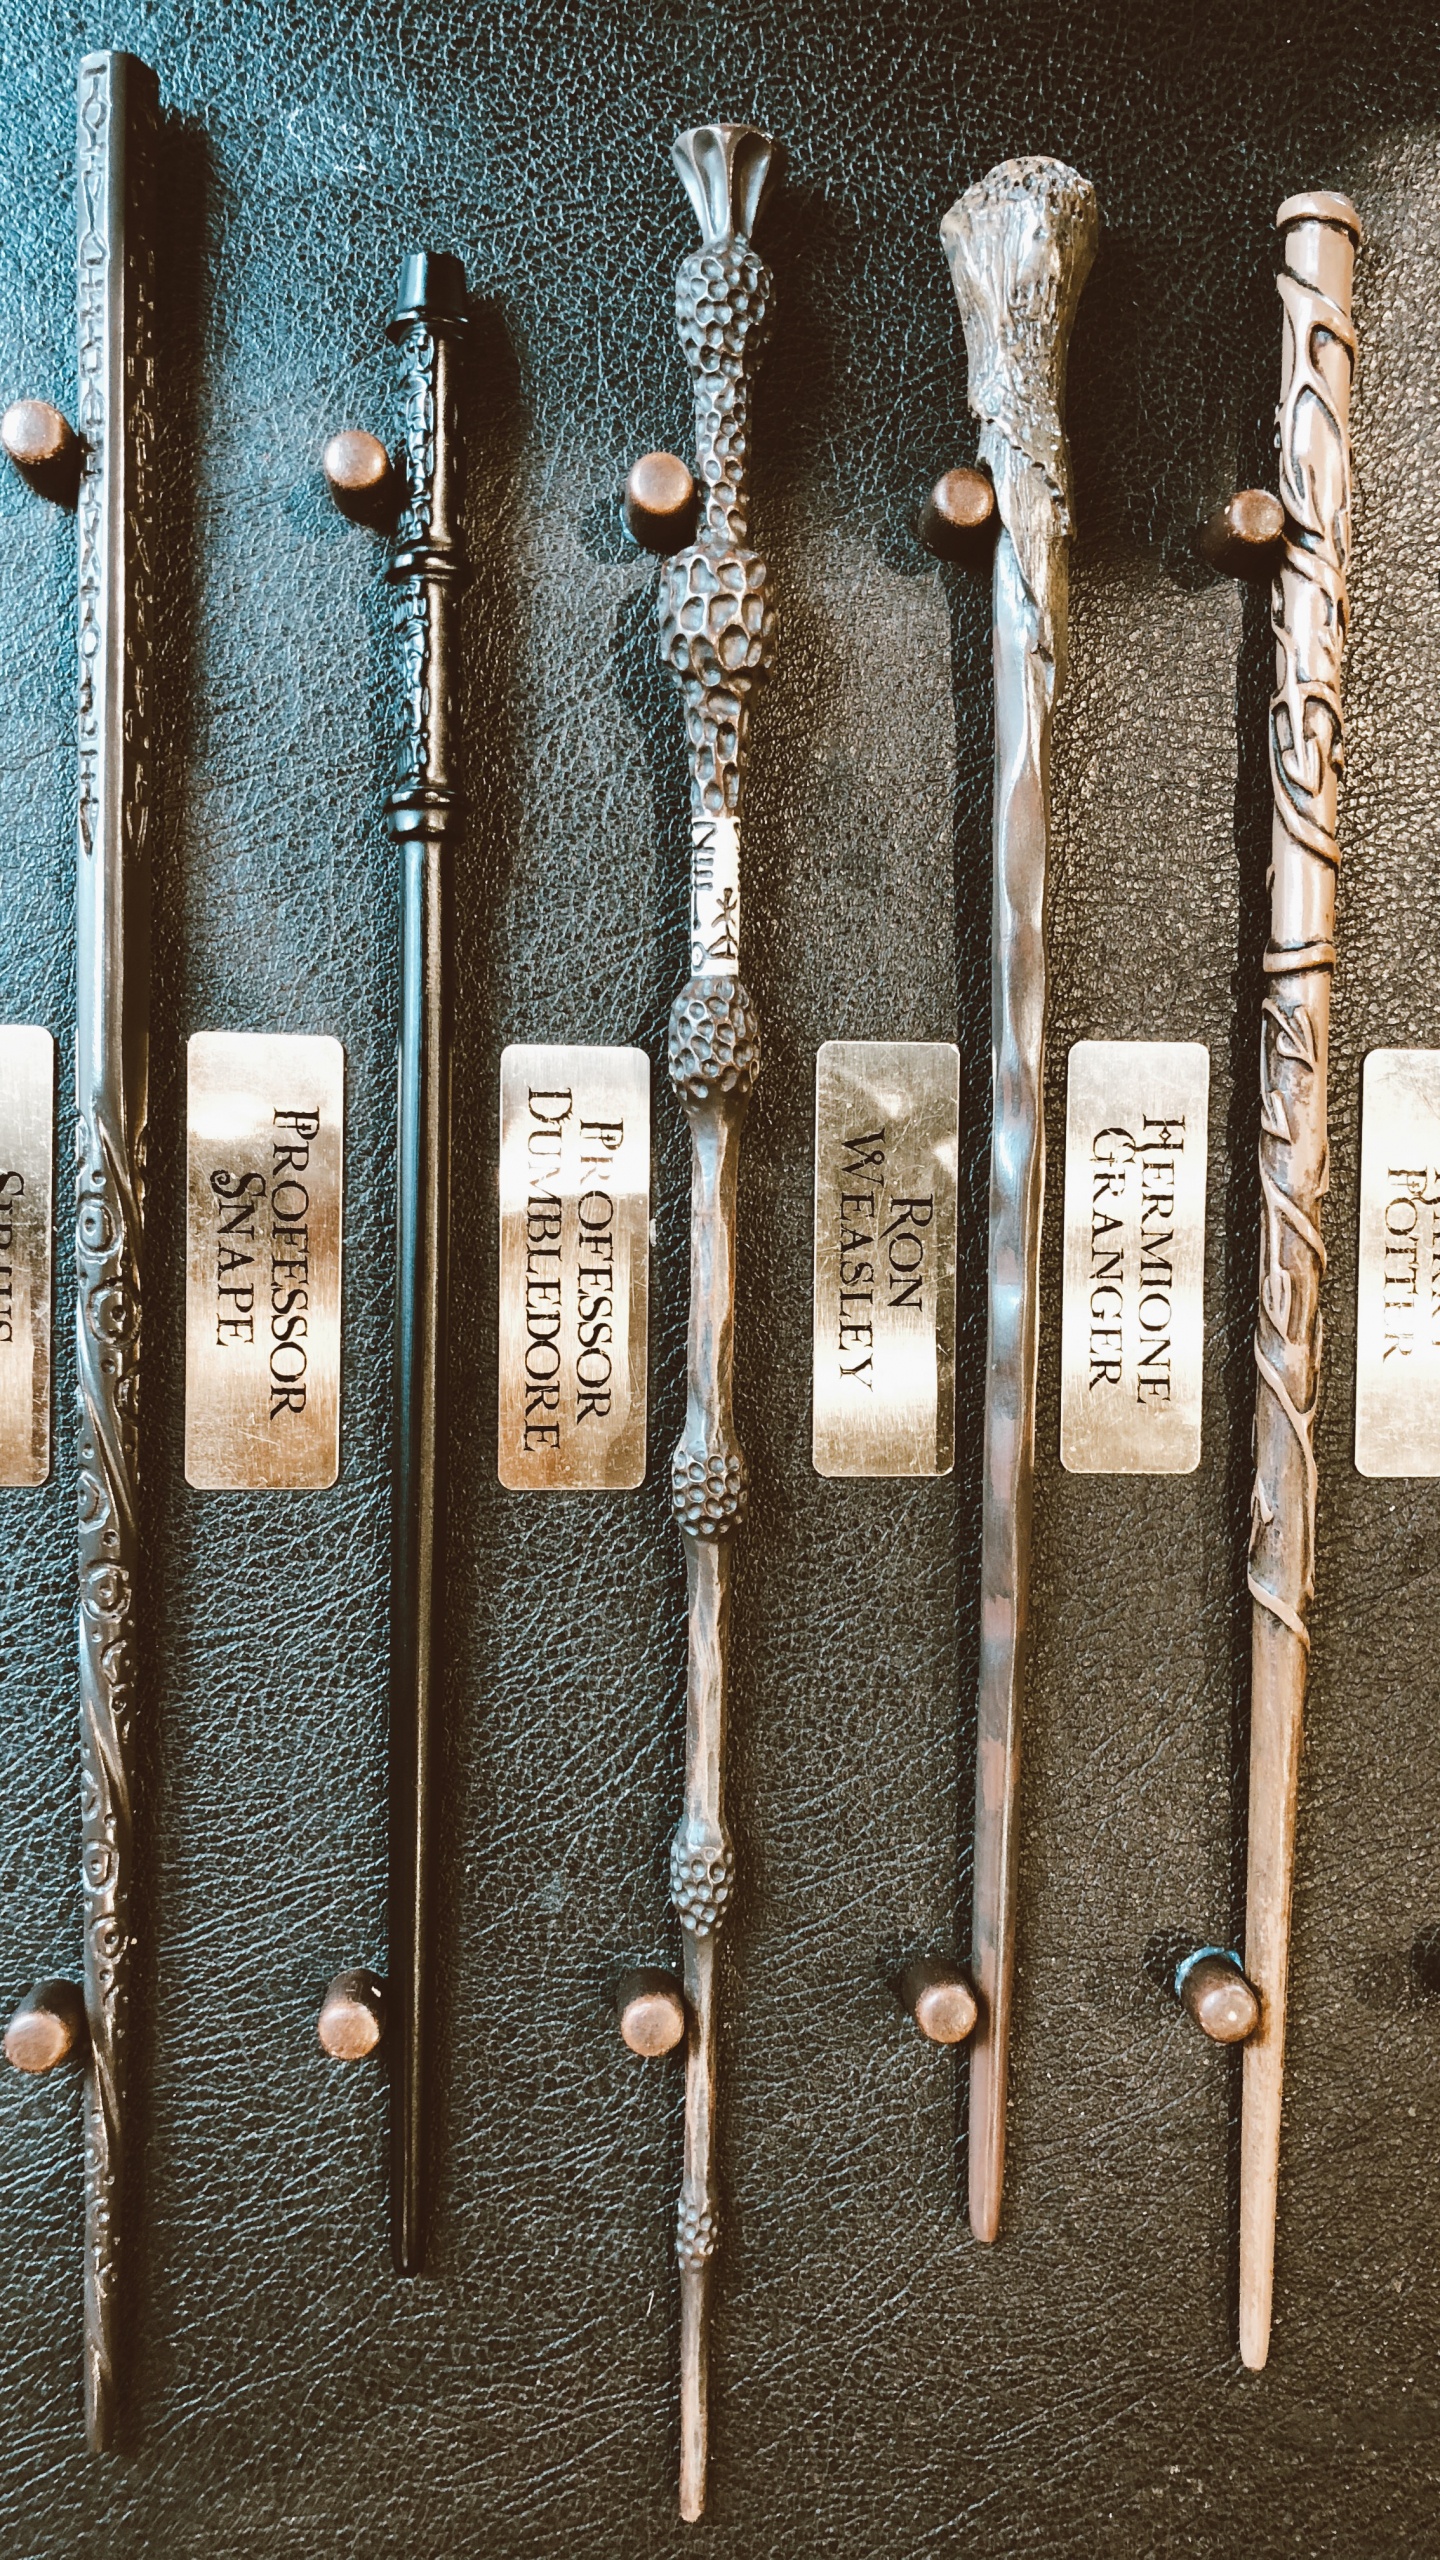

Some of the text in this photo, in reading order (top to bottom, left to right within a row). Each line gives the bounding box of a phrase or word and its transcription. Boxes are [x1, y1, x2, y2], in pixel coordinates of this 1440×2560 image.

[209, 1170, 268, 1347] SNAPE
[269, 1105, 321, 1420] PROFESSOR
[523, 1085, 574, 1453] DUMBLEDORE
[575, 1117, 625, 1425] PROFESSOR
[838, 1127, 887, 1393] WEASLEY
[879, 1193, 934, 1312] RON
[1088, 1126, 1138, 1391] GRANGER
[1131, 1113, 1186, 1405] HERMIONE
[1382, 1165, 1428, 1363] POTTER
